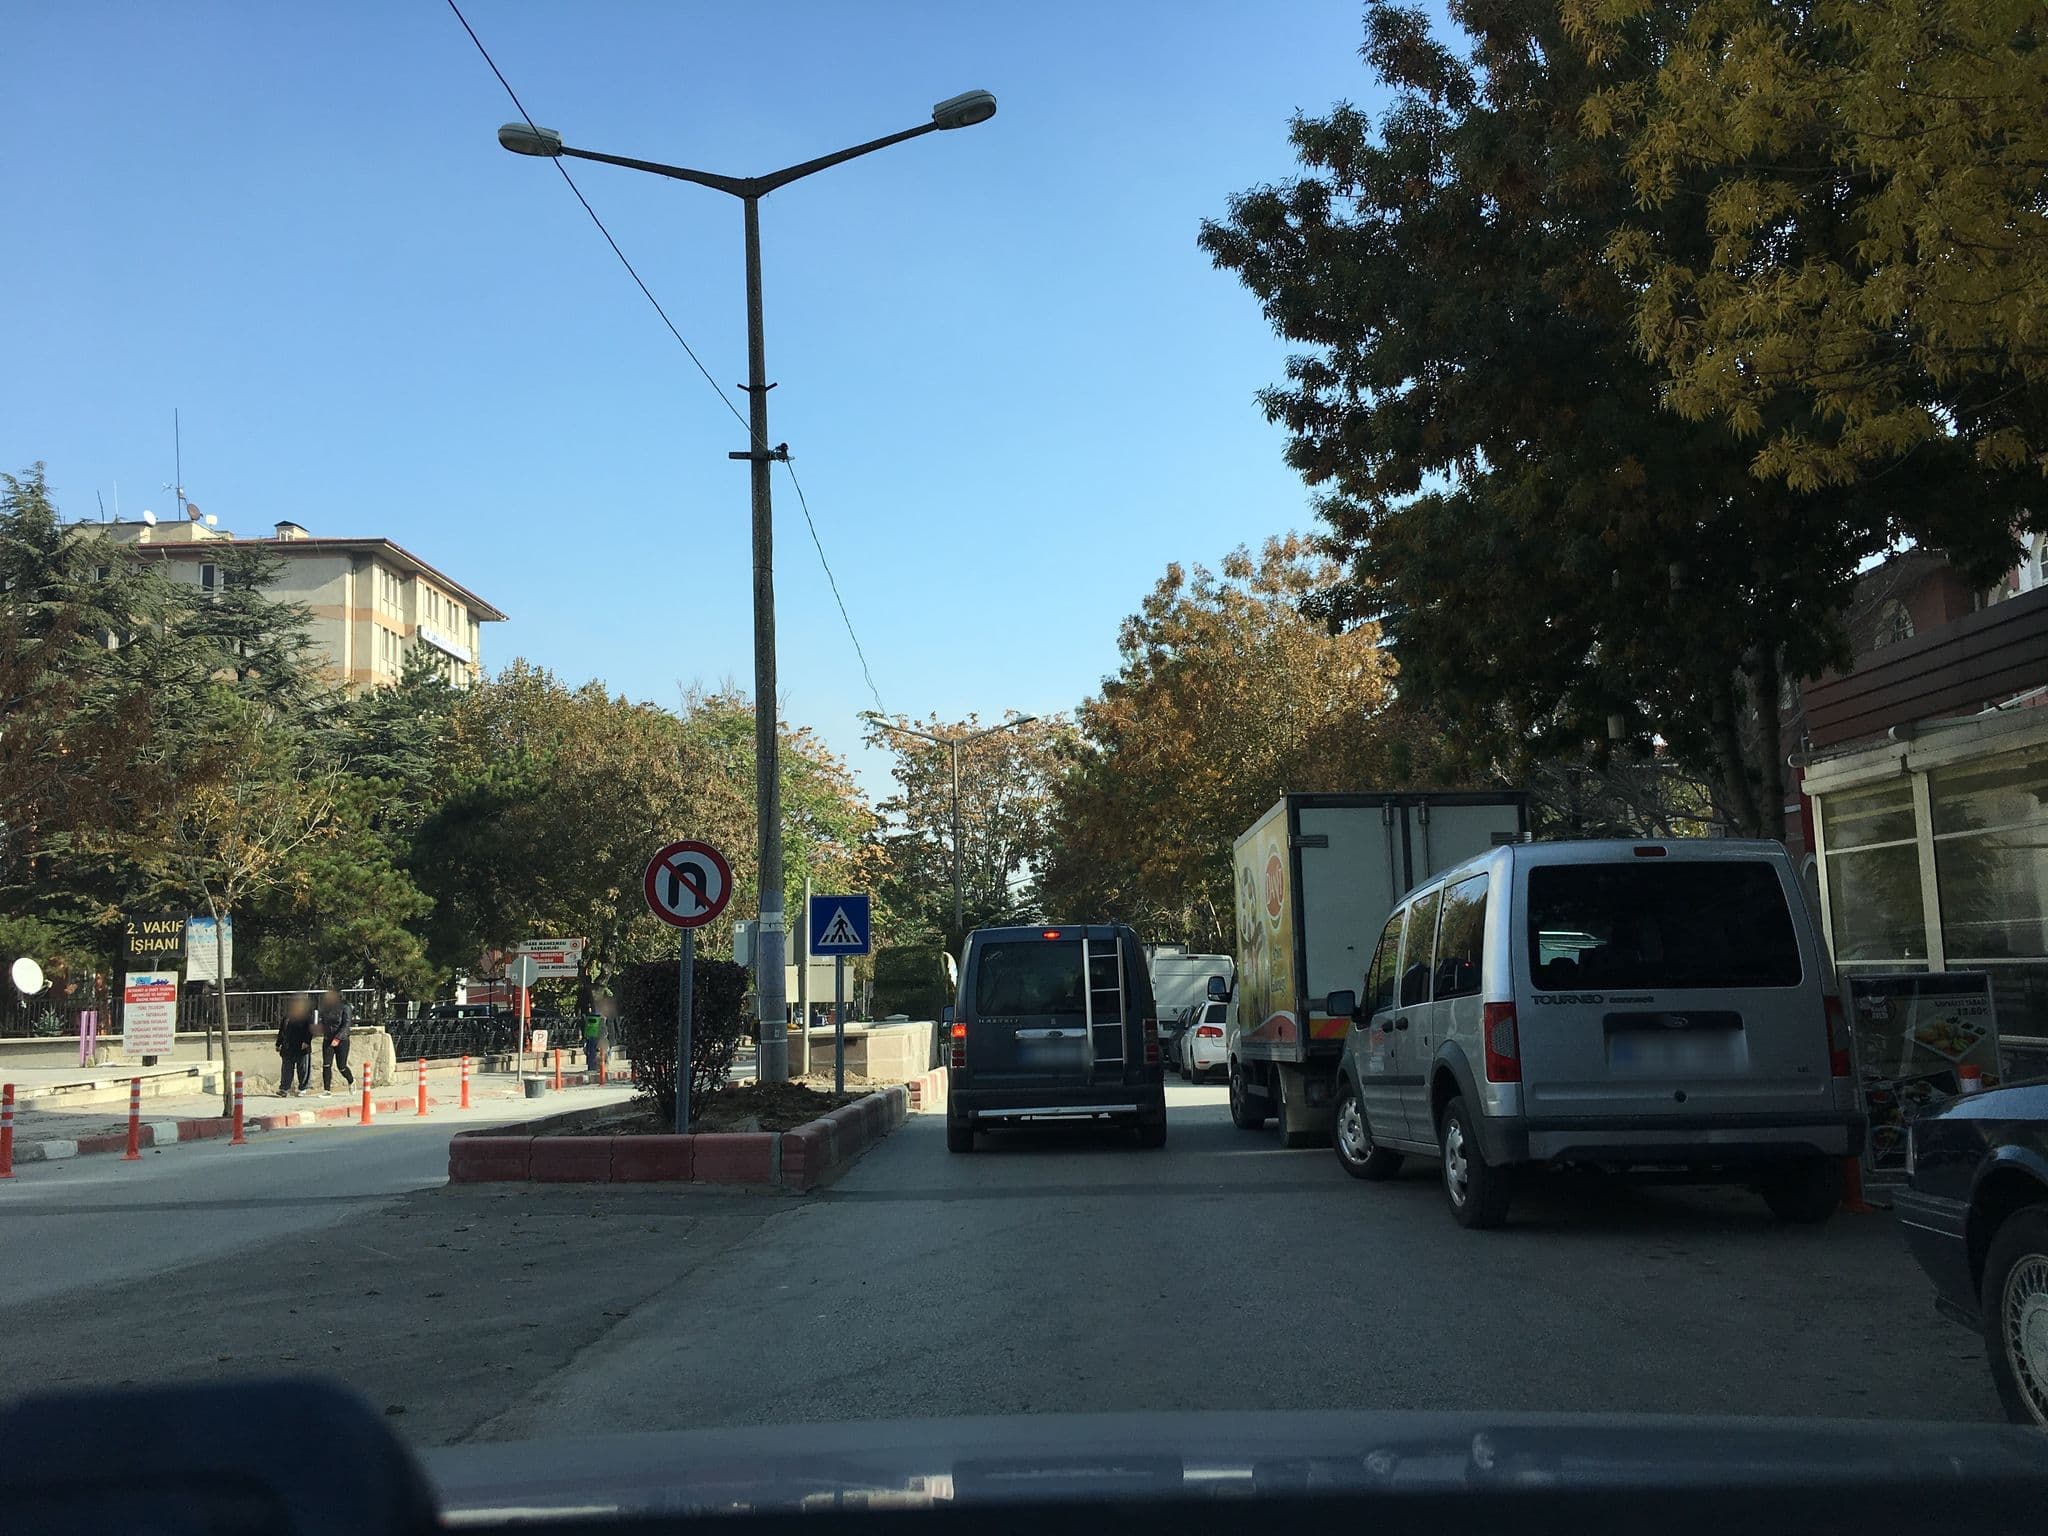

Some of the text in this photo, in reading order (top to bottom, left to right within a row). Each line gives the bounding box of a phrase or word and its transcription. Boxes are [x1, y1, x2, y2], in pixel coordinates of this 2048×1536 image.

[126, 922, 139, 935] 2.
[143, 919, 185, 934] VAKIF
[130, 936, 179, 955] İŞHANI
